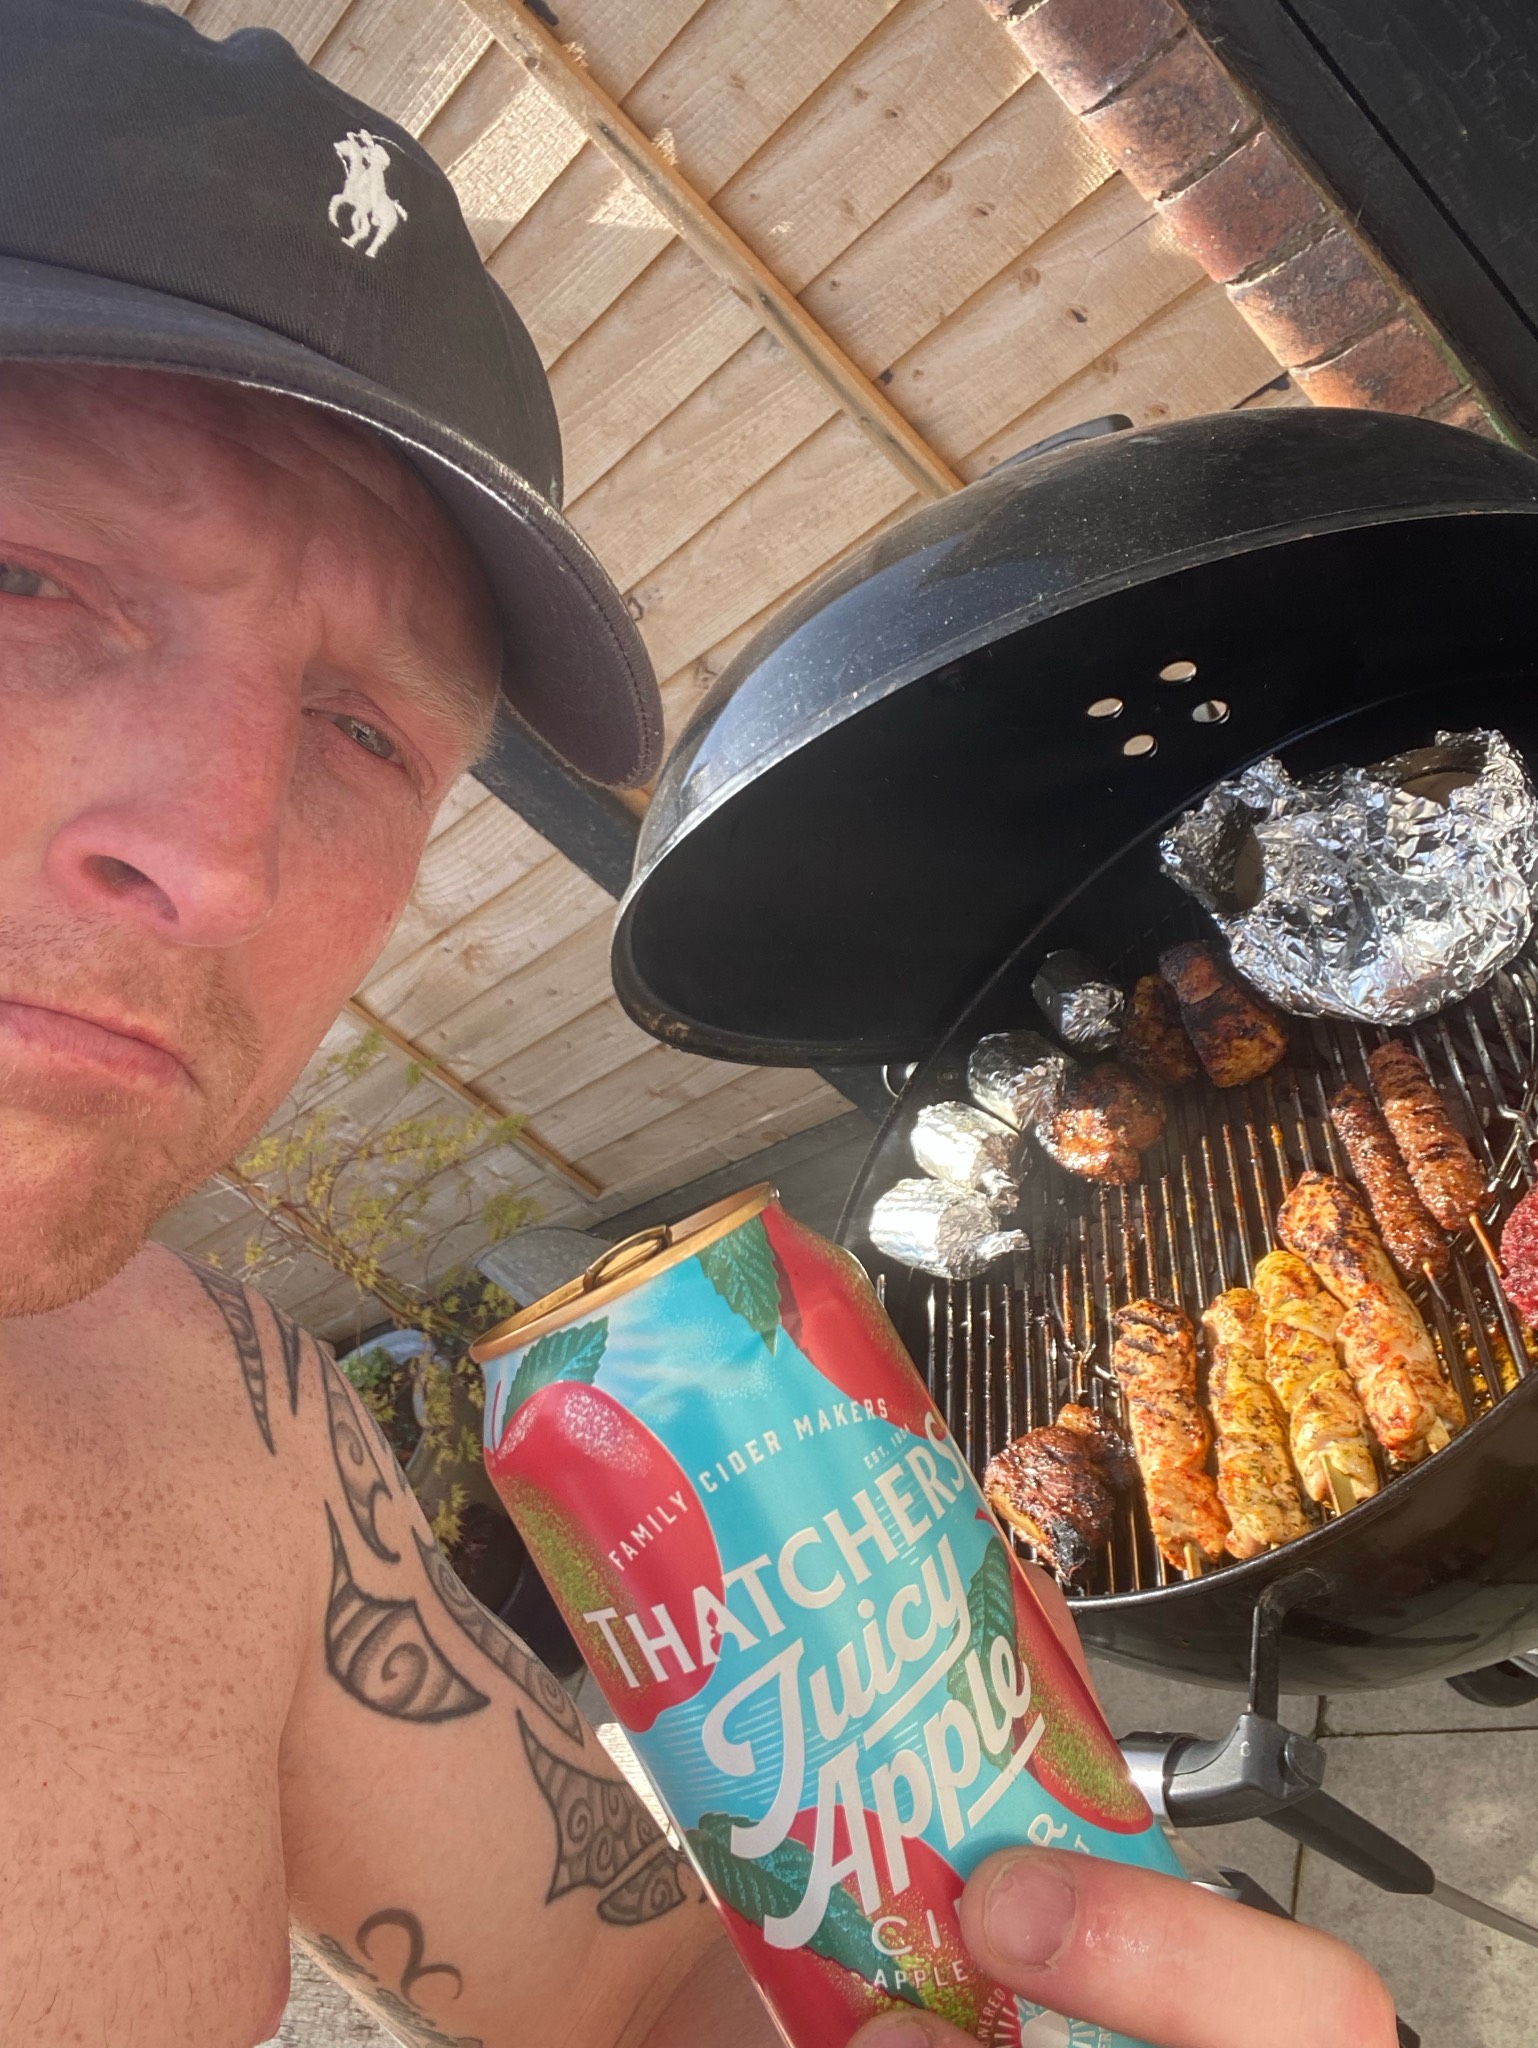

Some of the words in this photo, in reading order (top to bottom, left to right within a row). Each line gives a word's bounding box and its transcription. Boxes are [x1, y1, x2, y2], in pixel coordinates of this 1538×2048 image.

[583, 1410, 966, 1689] THATCHERS
[608, 1490, 689, 1572] FAMILY
[699, 1430, 782, 1494] CIDER
[793, 1397, 889, 1441] MAKERS
[702, 1533, 972, 1859] Juicy
[764, 1635, 1031, 1950] Apple
[873, 1959, 969, 1991] APPLE
